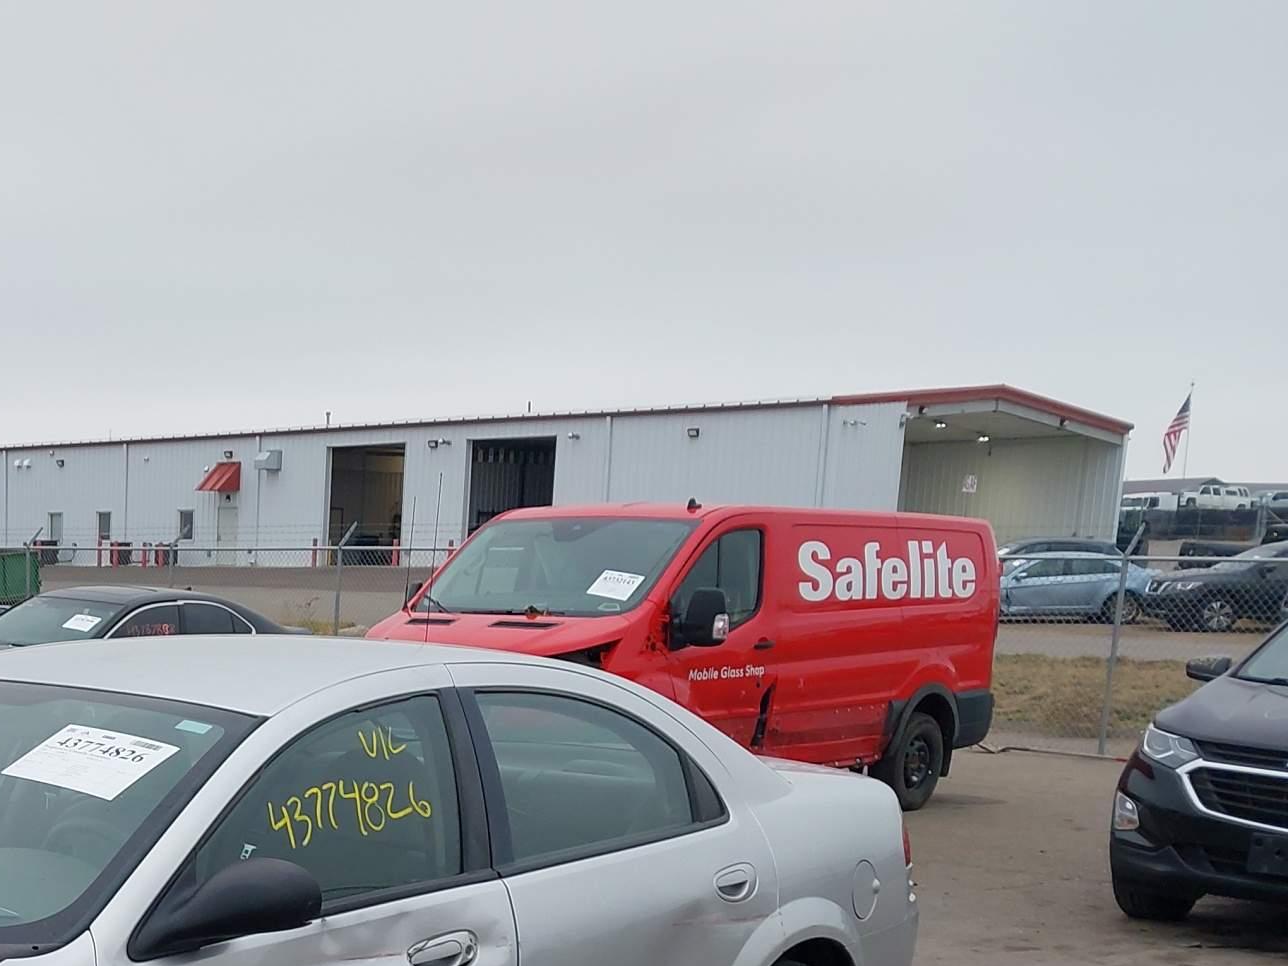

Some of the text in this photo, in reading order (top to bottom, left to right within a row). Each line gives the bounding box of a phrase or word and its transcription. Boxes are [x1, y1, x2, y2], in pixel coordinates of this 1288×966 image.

[797, 540, 976, 601] Safelite
[688, 664, 765, 680] Mobile Glass Shop
[56, 736, 148, 764] 43774826
[267, 780, 432, 848] 43774826
